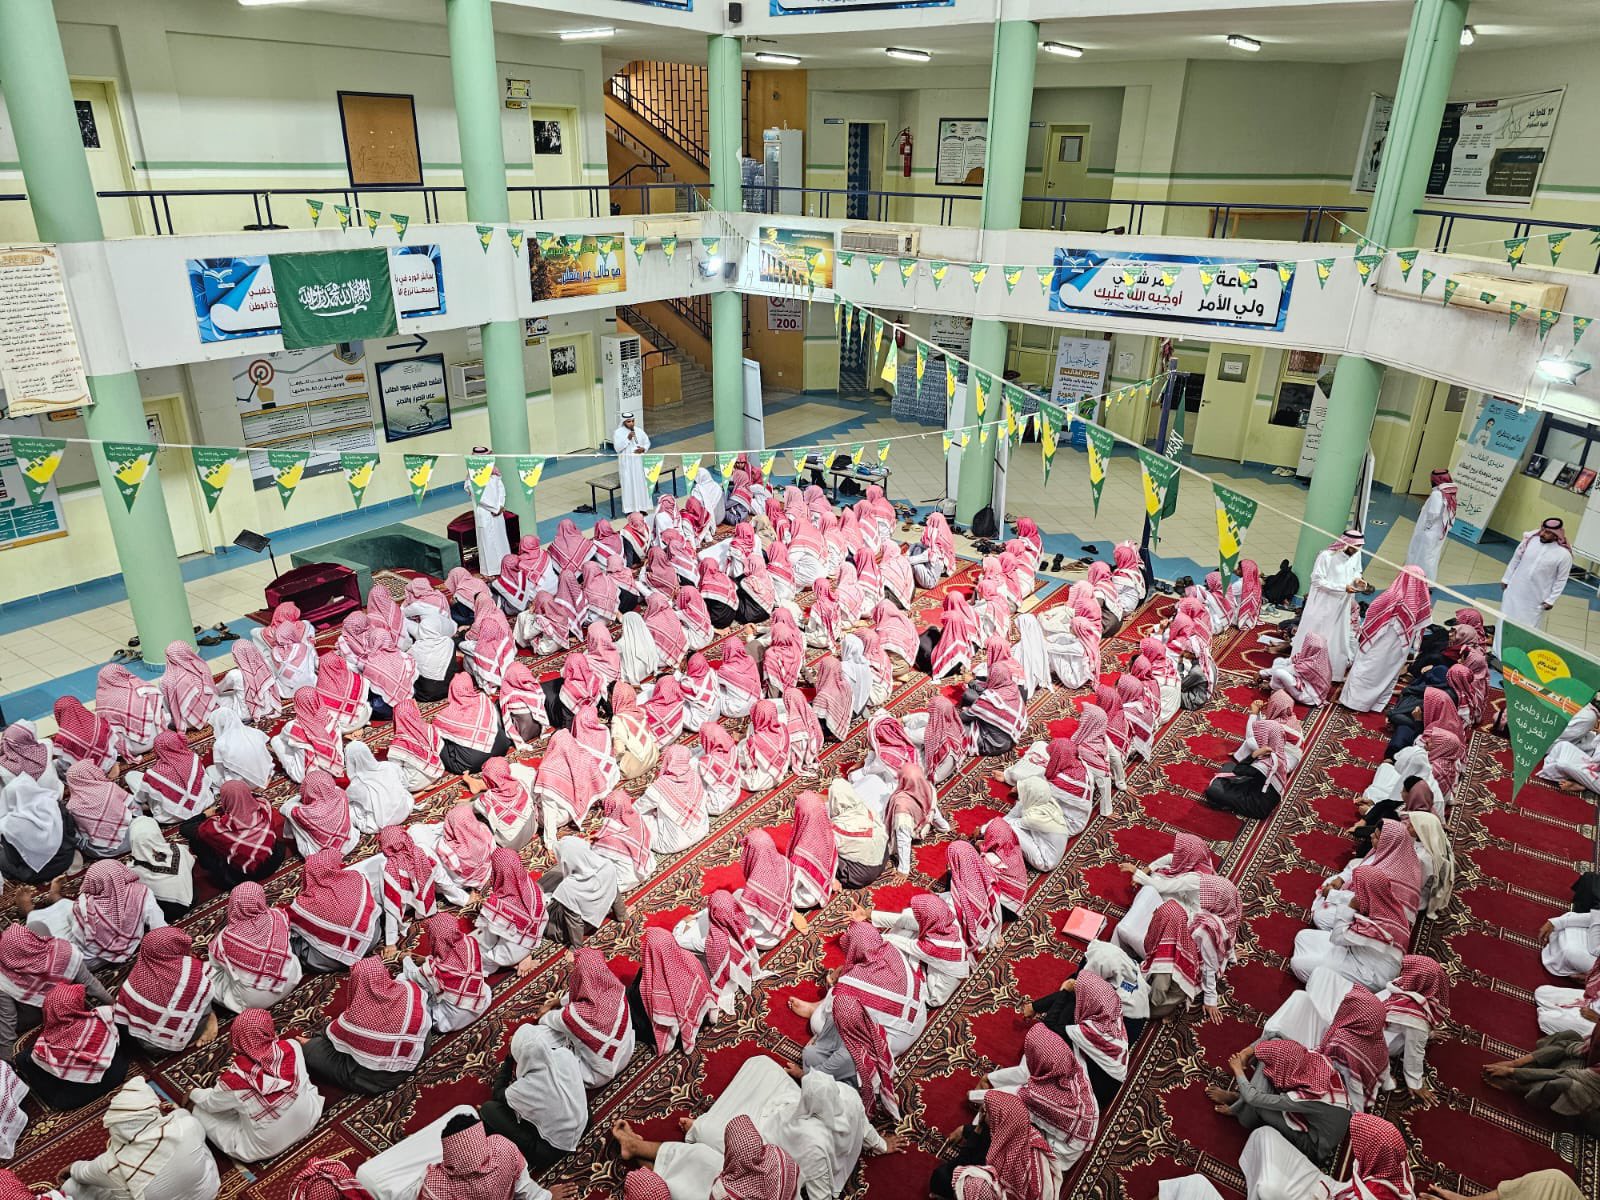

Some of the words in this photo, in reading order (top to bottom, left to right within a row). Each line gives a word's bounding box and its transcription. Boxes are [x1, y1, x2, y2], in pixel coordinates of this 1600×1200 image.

[1094, 287, 1125, 301] عليك
[1148, 290, 1183, 306] أوجبه
[249, 301, 270, 312] الوطن
[1197, 294, 1231, 312] الأمر
[1233, 299, 1264, 319] ولي
[776, 319, 797, 329] 200
[1513, 699, 1540, 720] وطموح
[1515, 717, 1528, 730] فيه
[1541, 714, 1558, 727] أمل
